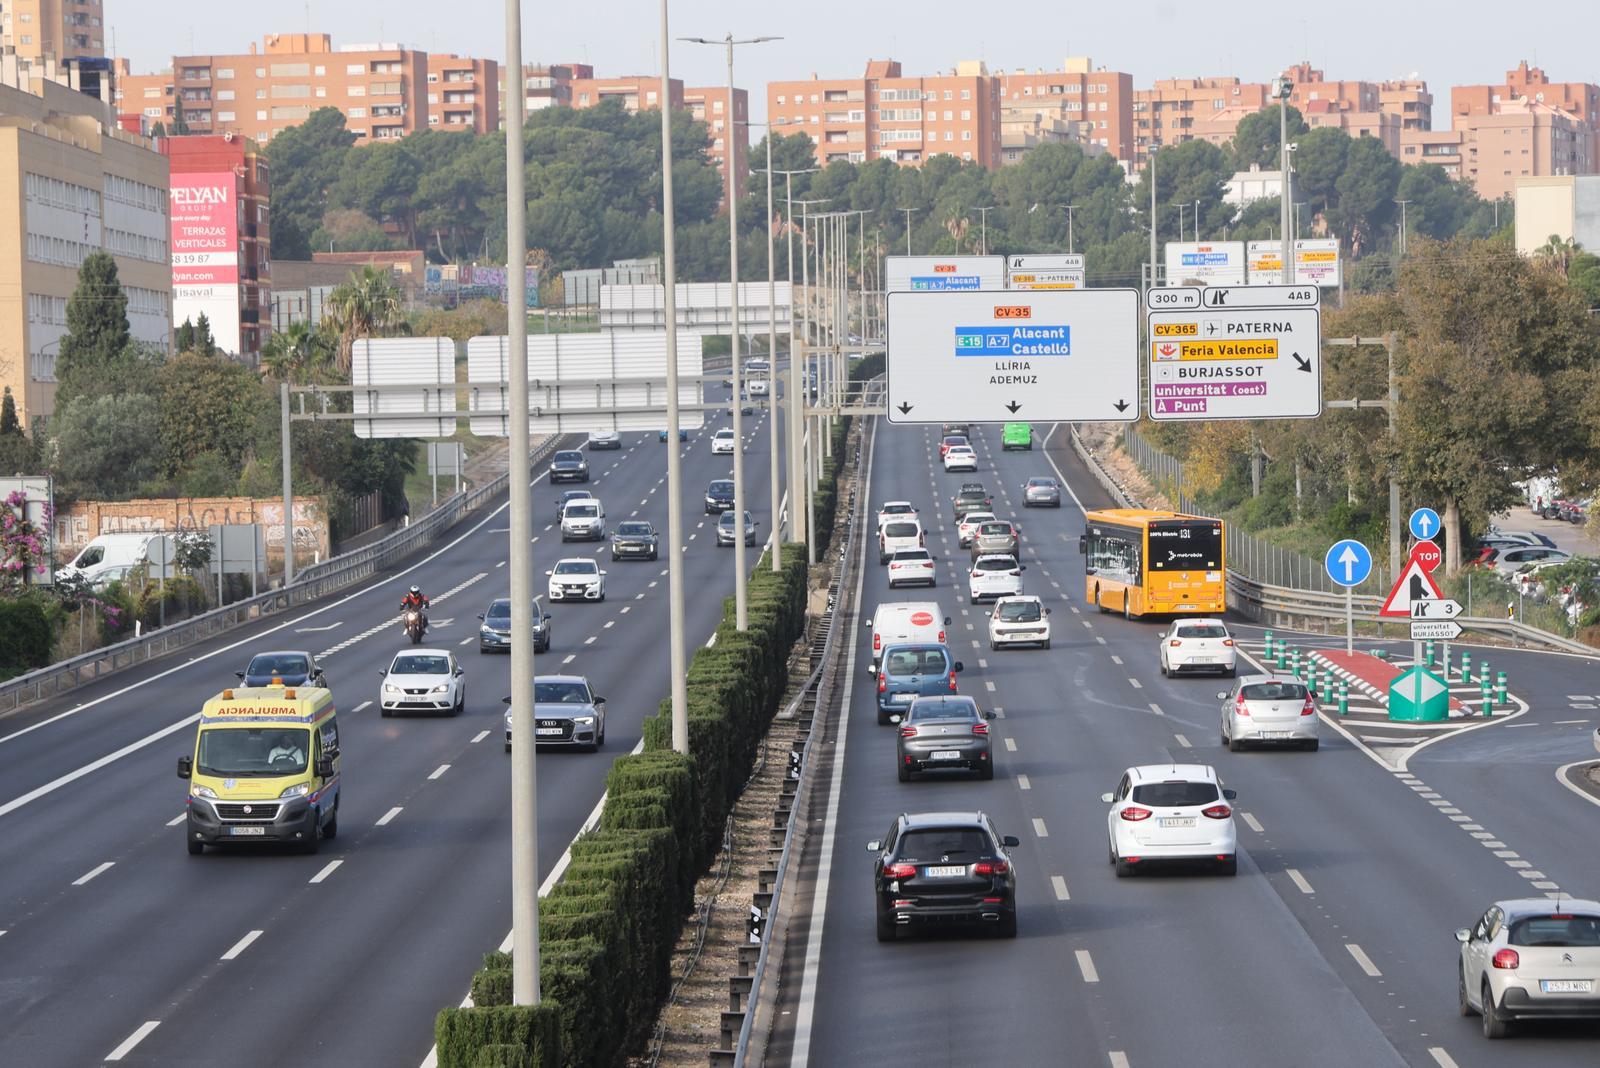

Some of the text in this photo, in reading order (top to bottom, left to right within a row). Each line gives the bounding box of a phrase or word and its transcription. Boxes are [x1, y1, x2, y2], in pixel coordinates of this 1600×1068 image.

[182, 226, 226, 235] TERRAZAS
[174, 239, 226, 248] VERTICALES
[184, 255, 195, 263] 19
[198, 255, 209, 263] 87
[172, 272, 214, 282] lyan.com
[946, 277, 978, 285] Alacant
[179, 288, 212, 297] isaval
[1288, 291, 1311, 300] 4AB
[1155, 294, 1178, 303] 300
[996, 308, 1029, 317] CV-35
[1156, 322, 1293, 335] CV-365 PATERNA
[1012, 328, 1064, 339] Alacant
[958, 337, 1008, 346] E-15 A-7
[1012, 343, 1068, 354] Castelló
[1182, 344, 1275, 357] Feria Valencia
[995, 360, 1031, 371] LLÍRIA
[1179, 366, 1264, 378] BURJASSOT
[990, 375, 1037, 384] ADEMUZ
[1156, 384, 1265, 396] universitat (oest)
[1157, 400, 1205, 413] À Punt
[1419, 552, 1438, 560] TOP
[1445, 604, 1453, 614] 3
